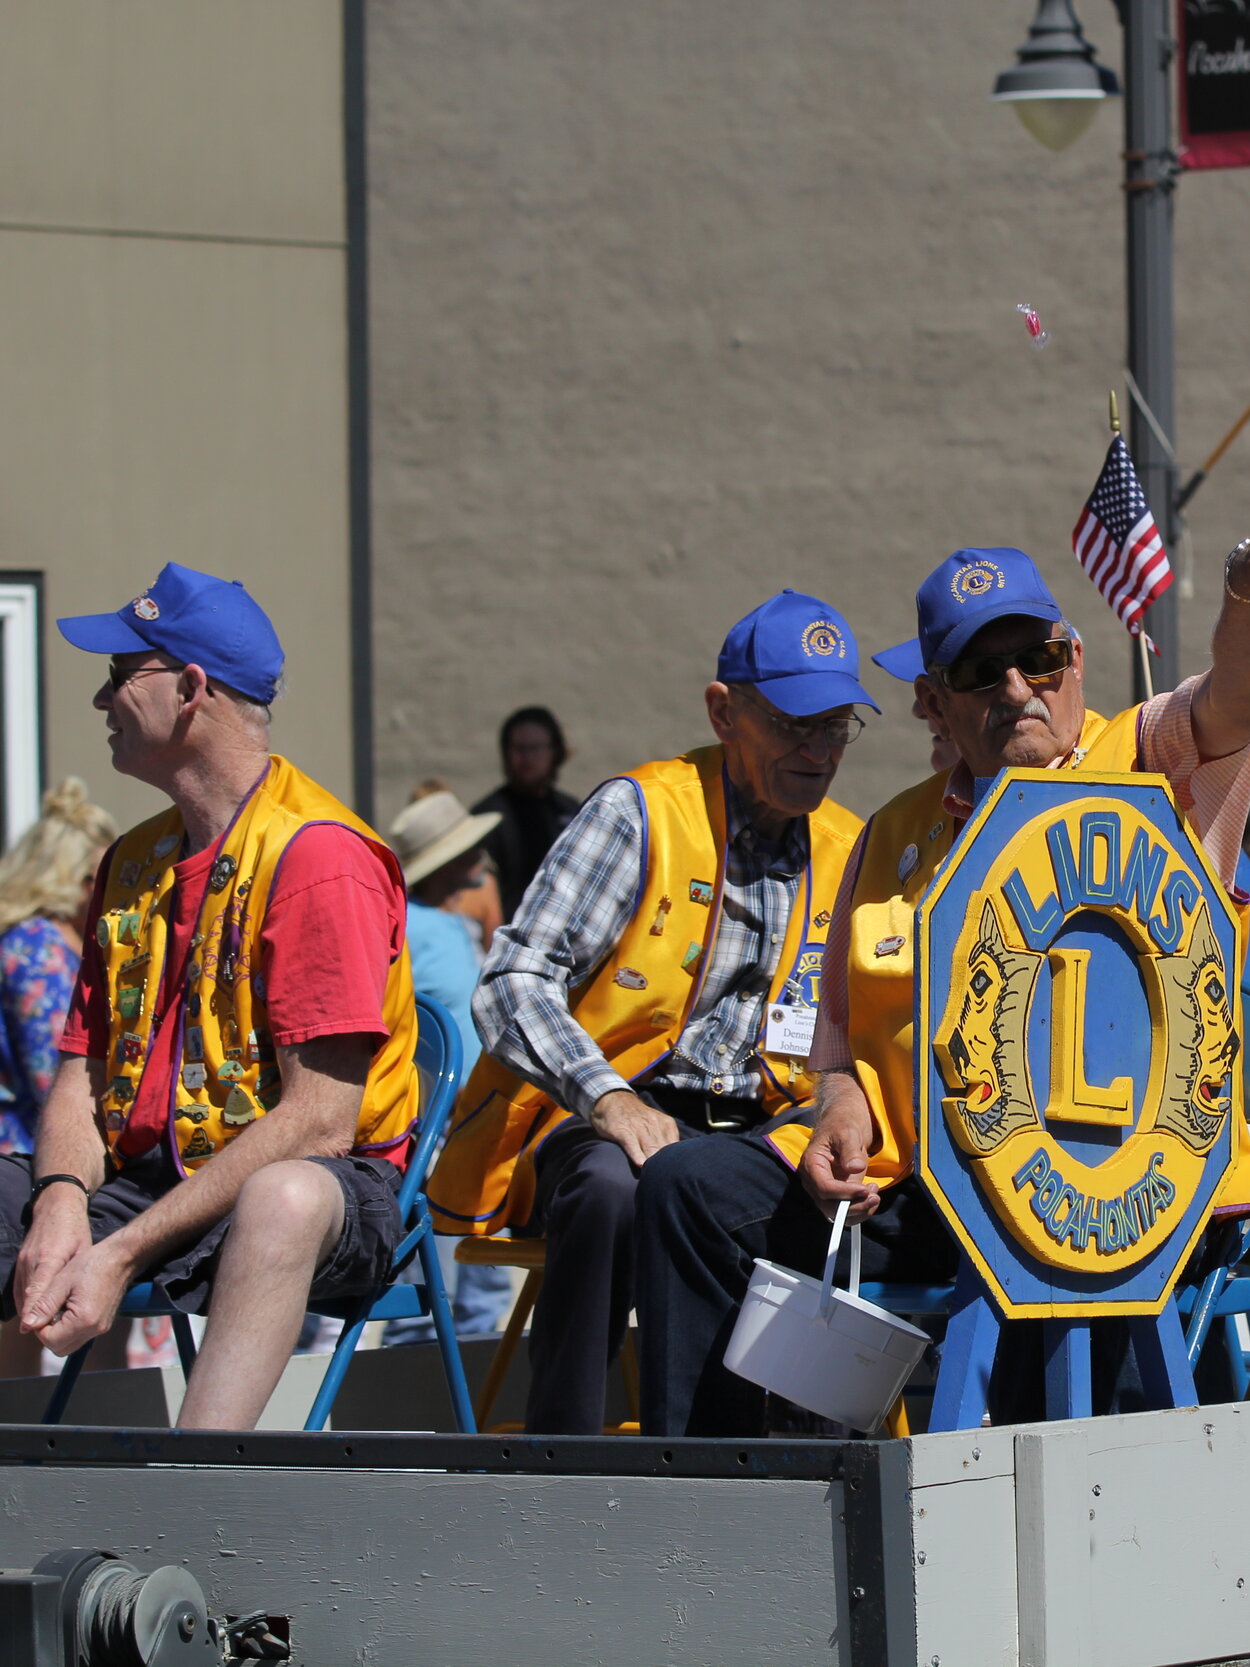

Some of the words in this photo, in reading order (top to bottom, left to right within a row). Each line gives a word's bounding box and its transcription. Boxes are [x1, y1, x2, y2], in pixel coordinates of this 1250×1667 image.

[975, 561, 999, 571] LIONS
[997, 571, 1006, 588] CLUB
[1001, 811, 1203, 953] LIONS
[780, 1040, 810, 1054] Johnso
[783, 1027, 814, 1041] Dennis
[1043, 947, 1134, 1126] L
[1012, 1146, 1177, 1253] POCAHONTAS
